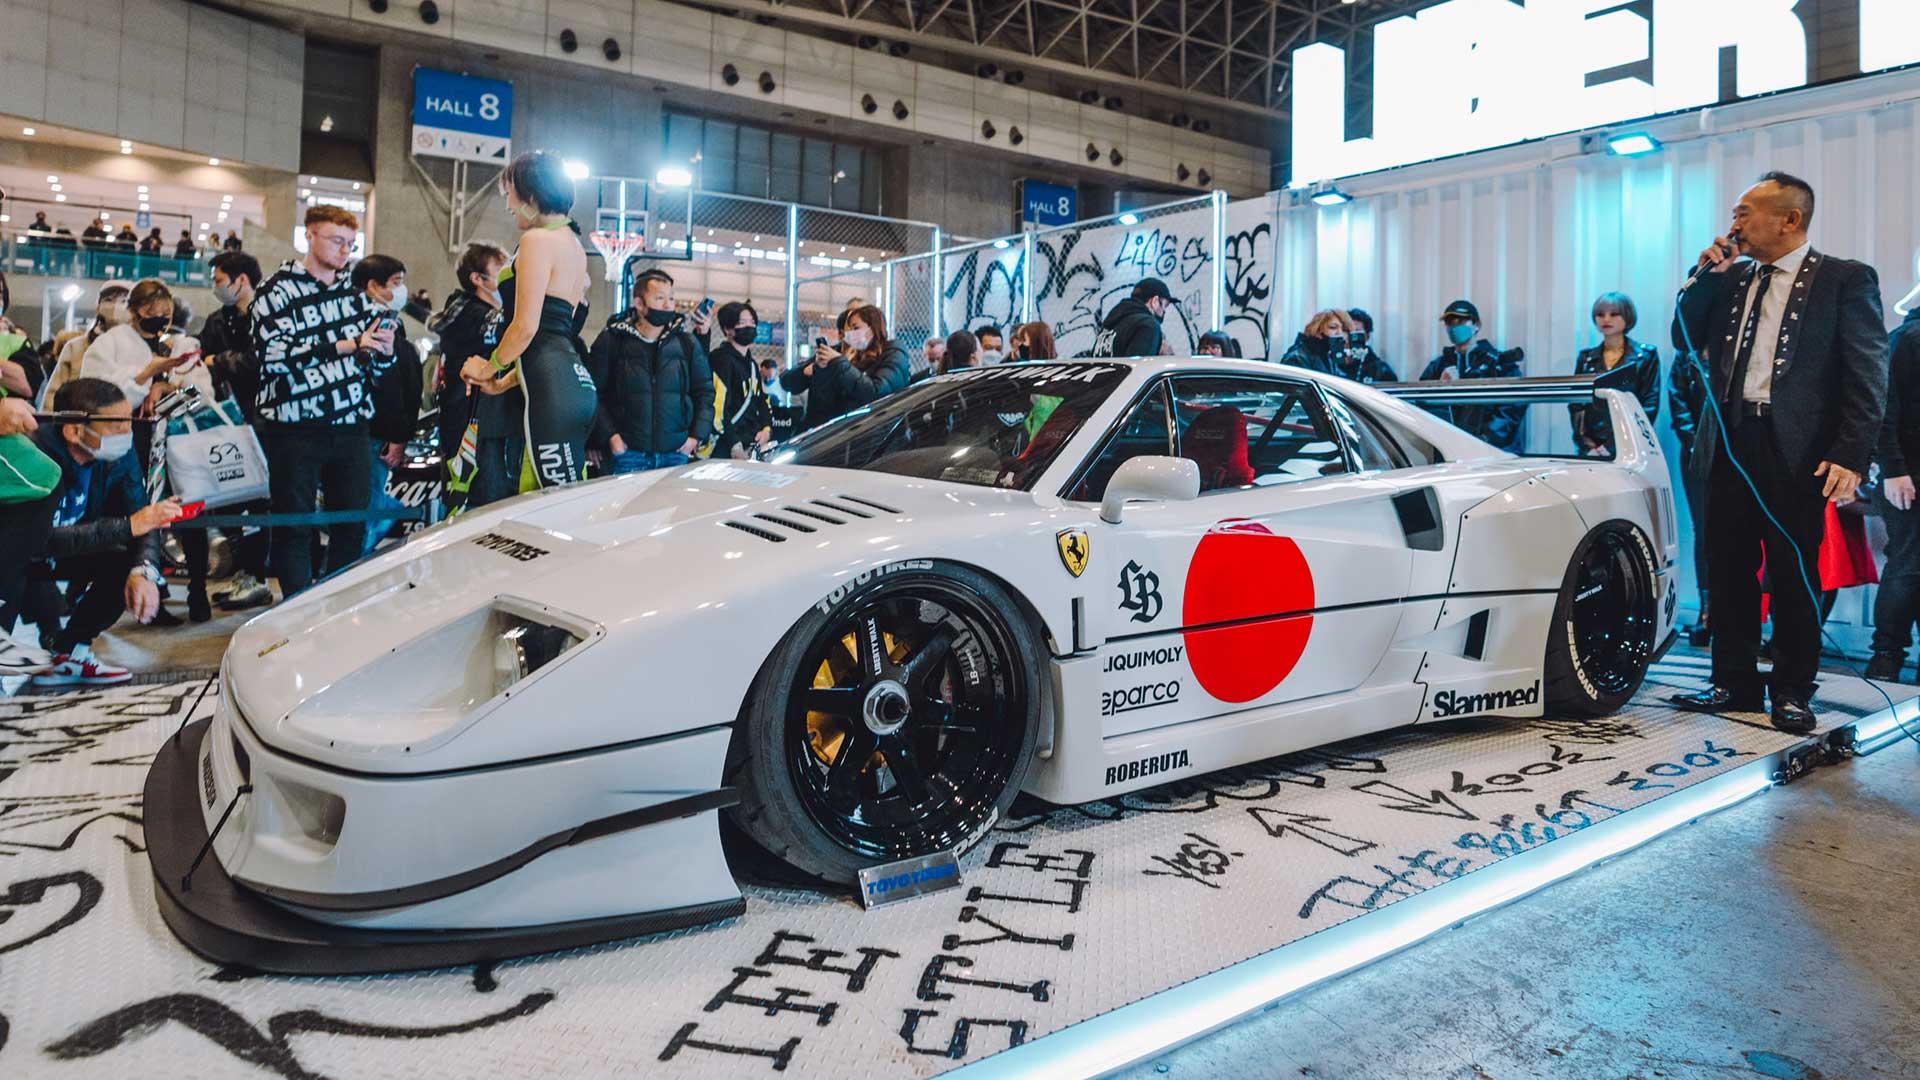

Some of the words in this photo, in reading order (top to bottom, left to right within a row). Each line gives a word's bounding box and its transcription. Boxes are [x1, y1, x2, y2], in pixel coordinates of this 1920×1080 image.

[426, 96, 473, 117] HALL
[479, 93, 499, 120] 8
[1030, 200, 1055, 215] HALL
[1058, 197, 1070, 217] 8
[815, 569, 872, 615] TOYO
[867, 617, 878, 643] WALK
[870, 641, 882, 676] LIBERTY
[1432, 679, 1541, 719] Slammed
[1577, 668, 1598, 701] TOYO
[866, 874, 911, 896] TOYO
[899, 841, 1097, 1060] STYLE
